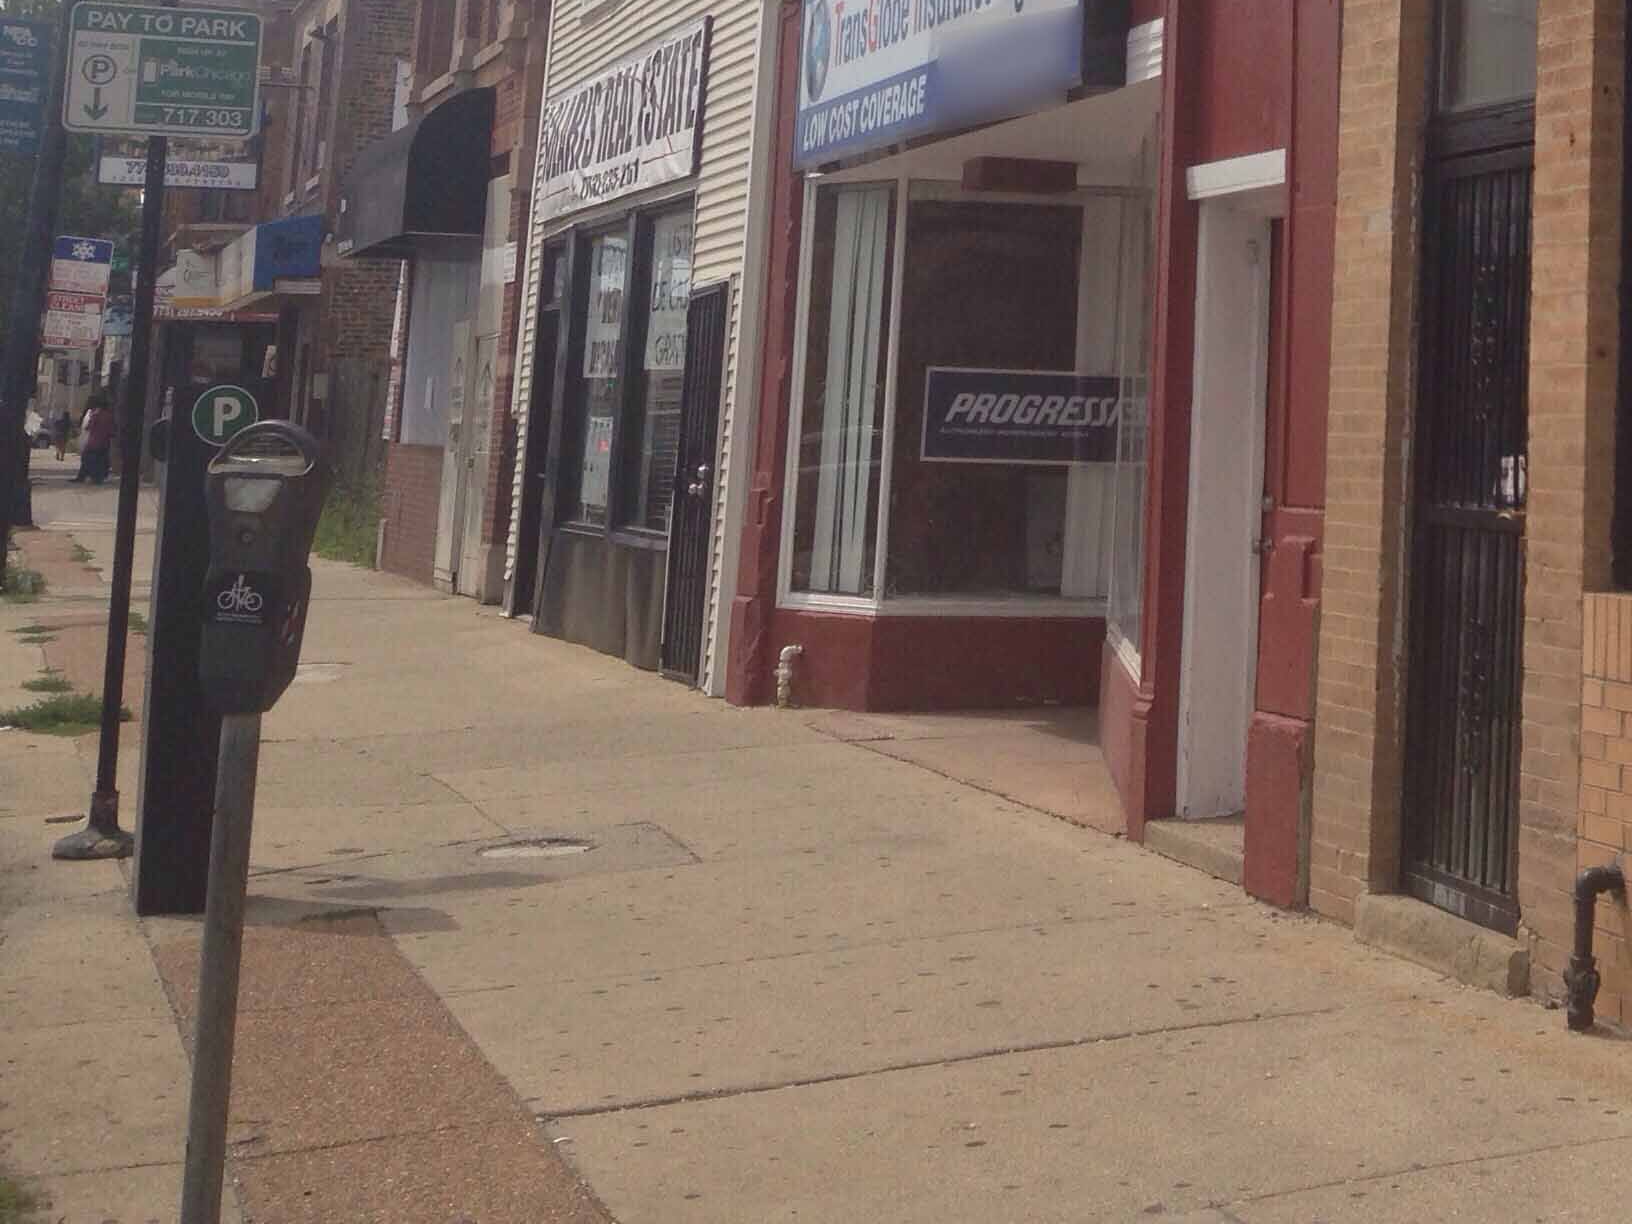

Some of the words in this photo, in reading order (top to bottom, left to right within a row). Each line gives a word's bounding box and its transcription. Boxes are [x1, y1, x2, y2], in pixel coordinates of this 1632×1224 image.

[87, 10, 133, 30] PAY
[140, 13, 173, 33] TO
[180, 16, 247, 38] PARK
[596, 62, 639, 164] REAL
[637, 29, 703, 147] ESTATE
[803, 110, 827, 151] LOW
[828, 99, 859, 139] COST
[860, 75, 928, 132] COVERAGE
[211, 396, 242, 437] P
